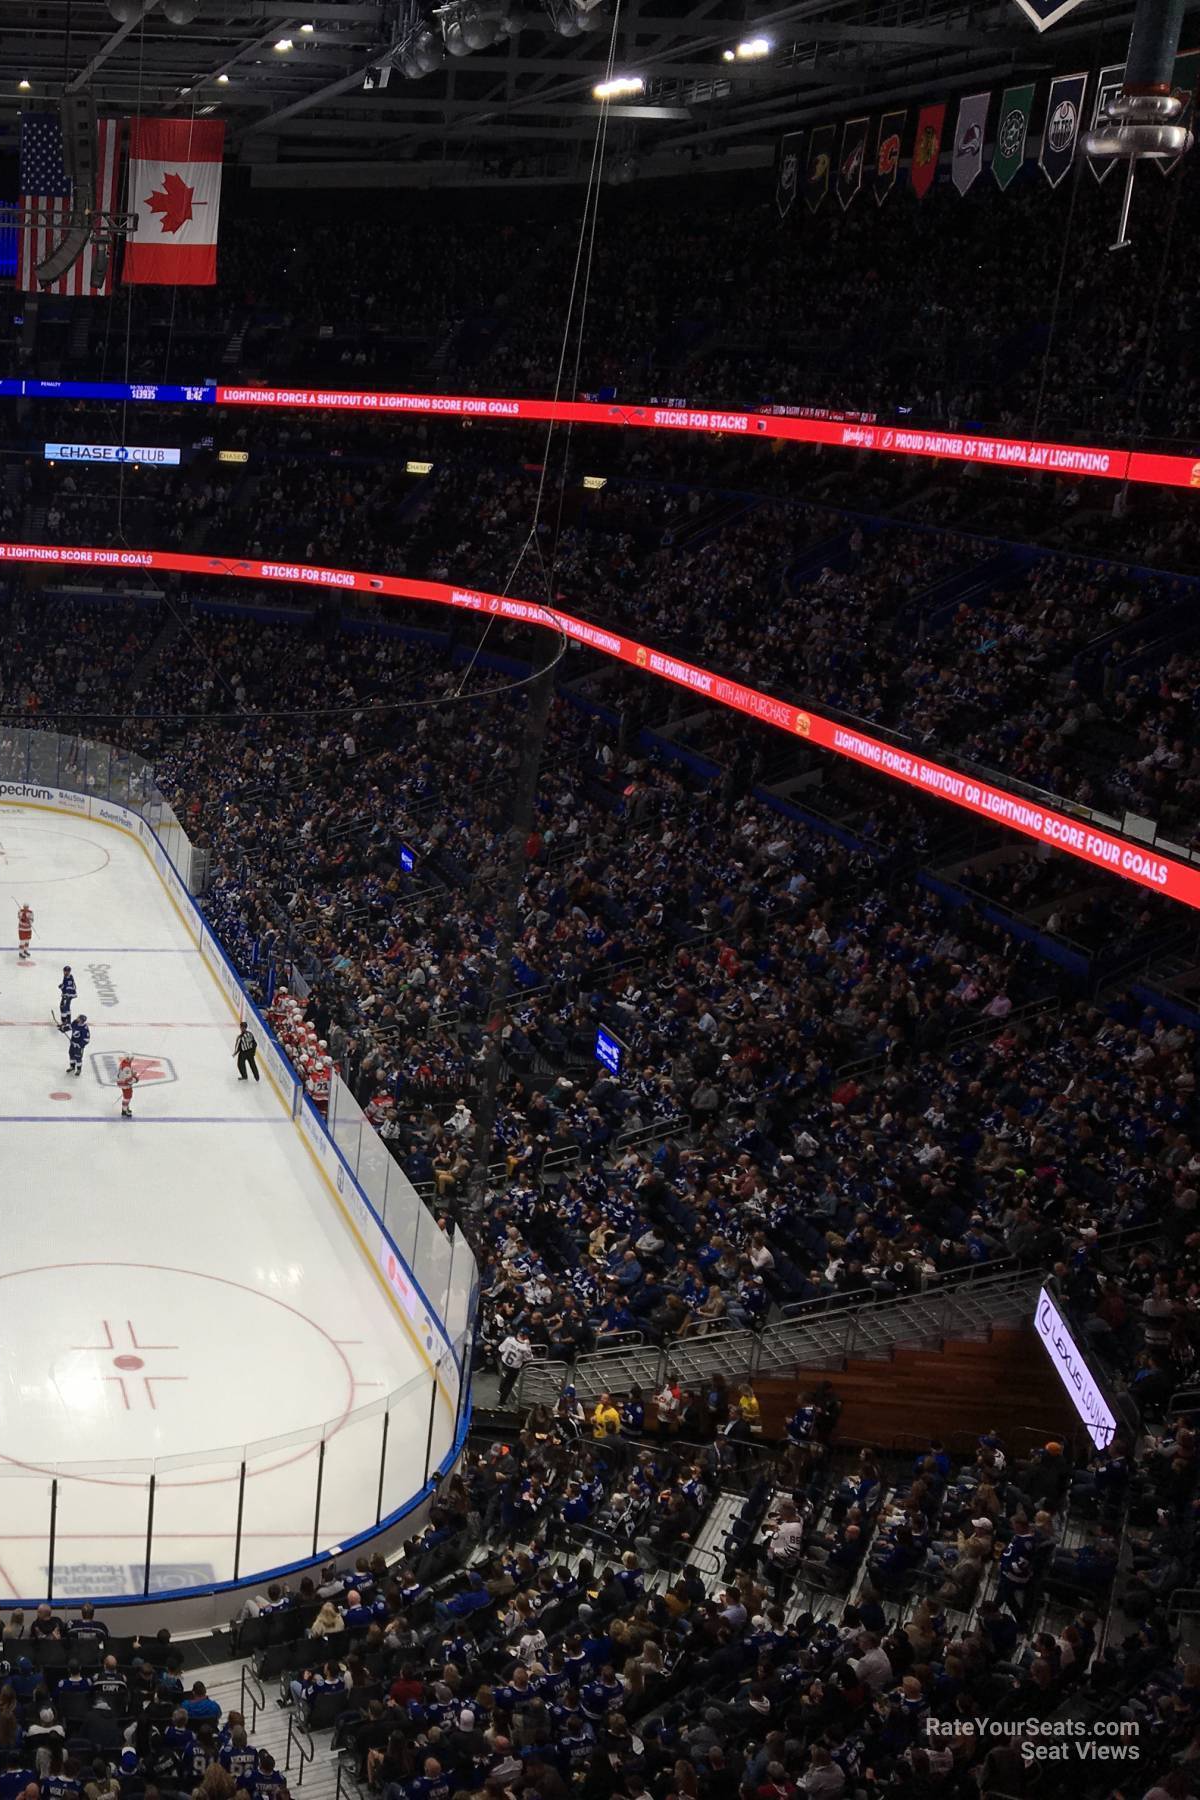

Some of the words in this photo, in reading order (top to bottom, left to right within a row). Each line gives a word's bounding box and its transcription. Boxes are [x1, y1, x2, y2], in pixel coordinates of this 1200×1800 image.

[224, 391, 275, 401] LIGHTNING
[277, 393, 307, 403] FORCE
[308, 395, 316, 403] A
[317, 395, 360, 405] SHUTOUT
[363, 396, 377, 406] OR
[379, 397, 431, 408] LIGHTNING
[432, 399, 462, 410] SCORE
[463, 401, 487, 411] FOUR
[488, 402, 519, 413] GOALS
[654, 412, 688, 425] STICKS
[689, 414, 708, 426] FOR
[710, 415, 748, 429] STACKS
[59, 446, 112, 459] CHASE
[132, 449, 165, 462] CLUB
[896, 434, 923, 449] PROUD
[924, 437, 963, 453] PARTNER
[964, 441, 976, 455] OF
[977, 442, 994, 458] THE
[995, 444, 1028, 461] TAMPA
[1029, 448, 1049, 464] BAY
[1049, 450, 1110, 471] LIGHTNING
[7, 548, 59, 559] LIGHTNING
[60, 551, 93, 561] SCORE
[94, 553, 120, 562] FOUR
[121, 554, 153, 564] GOALS
[261, 565, 299, 578] STICKS
[301, 569, 320, 580] FOR
[320, 572, 355, 585] STACKS
[501, 602, 527, 616] PROUD
[834, 731, 881, 761] LIGHTNING
[882, 750, 911, 775] FORCE
[911, 763, 919, 779] A
[920, 766, 964, 796] SHUTOUT
[965, 785, 980, 804] OR
[981, 792, 1042, 830] LIGHTNING
[1044, 818, 1085, 849] SCORE
[1086, 835, 1120, 864] FOUR
[1122, 851, 1168, 884] GOALS
[506, 1351, 517, 1365] 6
[1052, 1324, 1083, 1390] LEXUS
